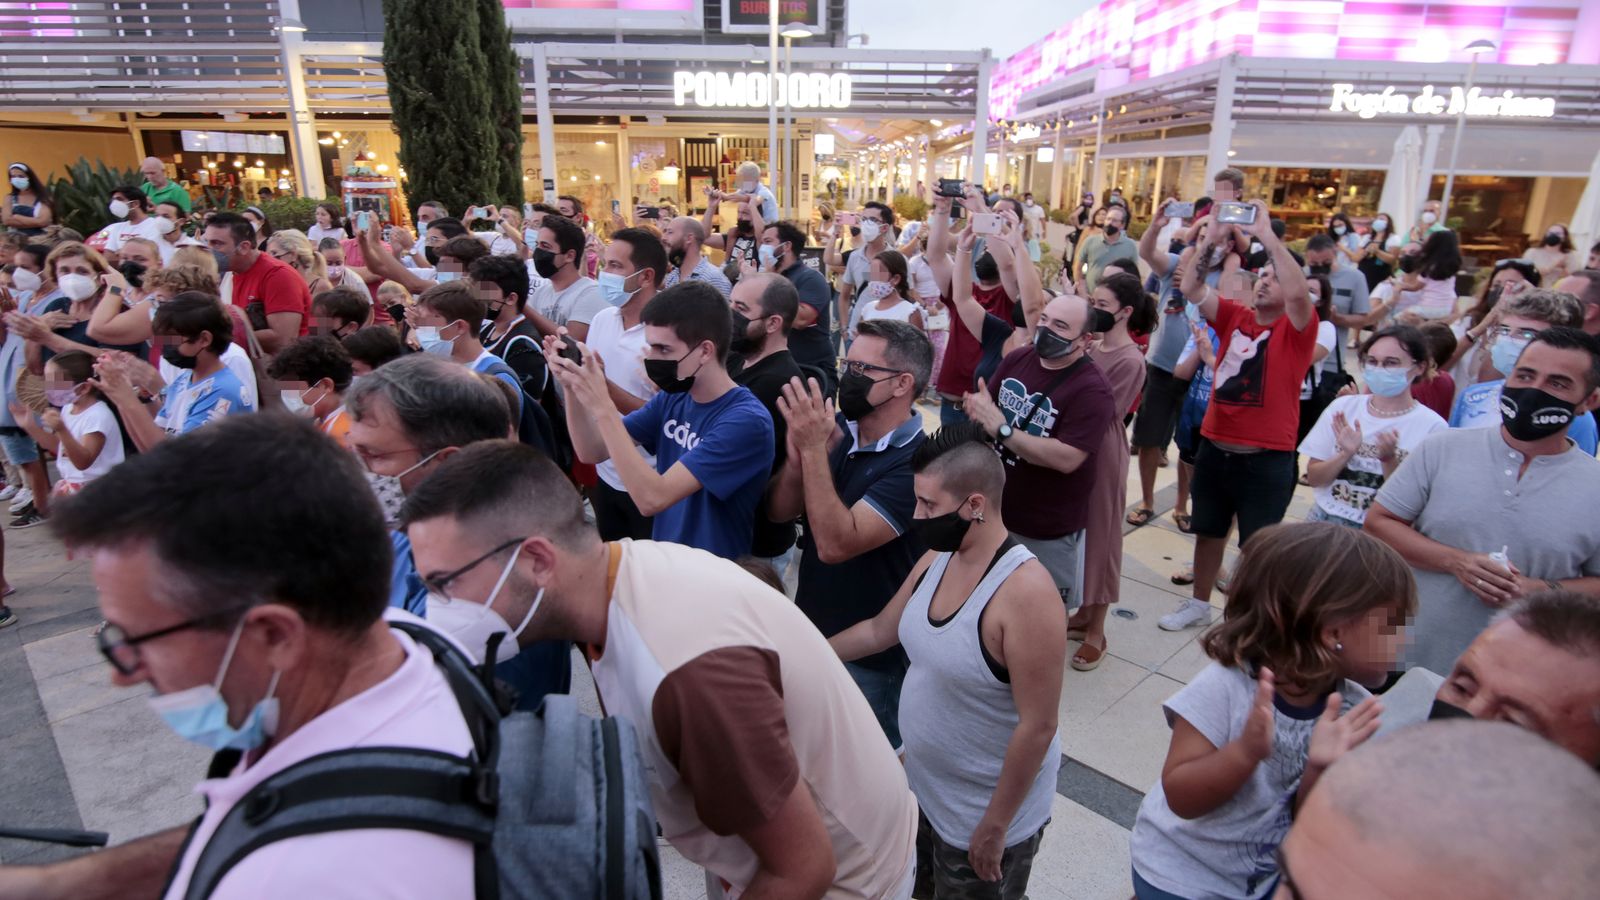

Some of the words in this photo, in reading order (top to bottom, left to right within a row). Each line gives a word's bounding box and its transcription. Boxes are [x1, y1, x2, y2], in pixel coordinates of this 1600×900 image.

[740, 1, 808, 14] BURTOS
[673, 71, 852, 108] POMODORO
[1329, 83, 1409, 118] Fogón
[1411, 85, 1446, 114] de
[1447, 86, 1555, 117] Mariana
[999, 388, 1049, 426] BROOKYN
